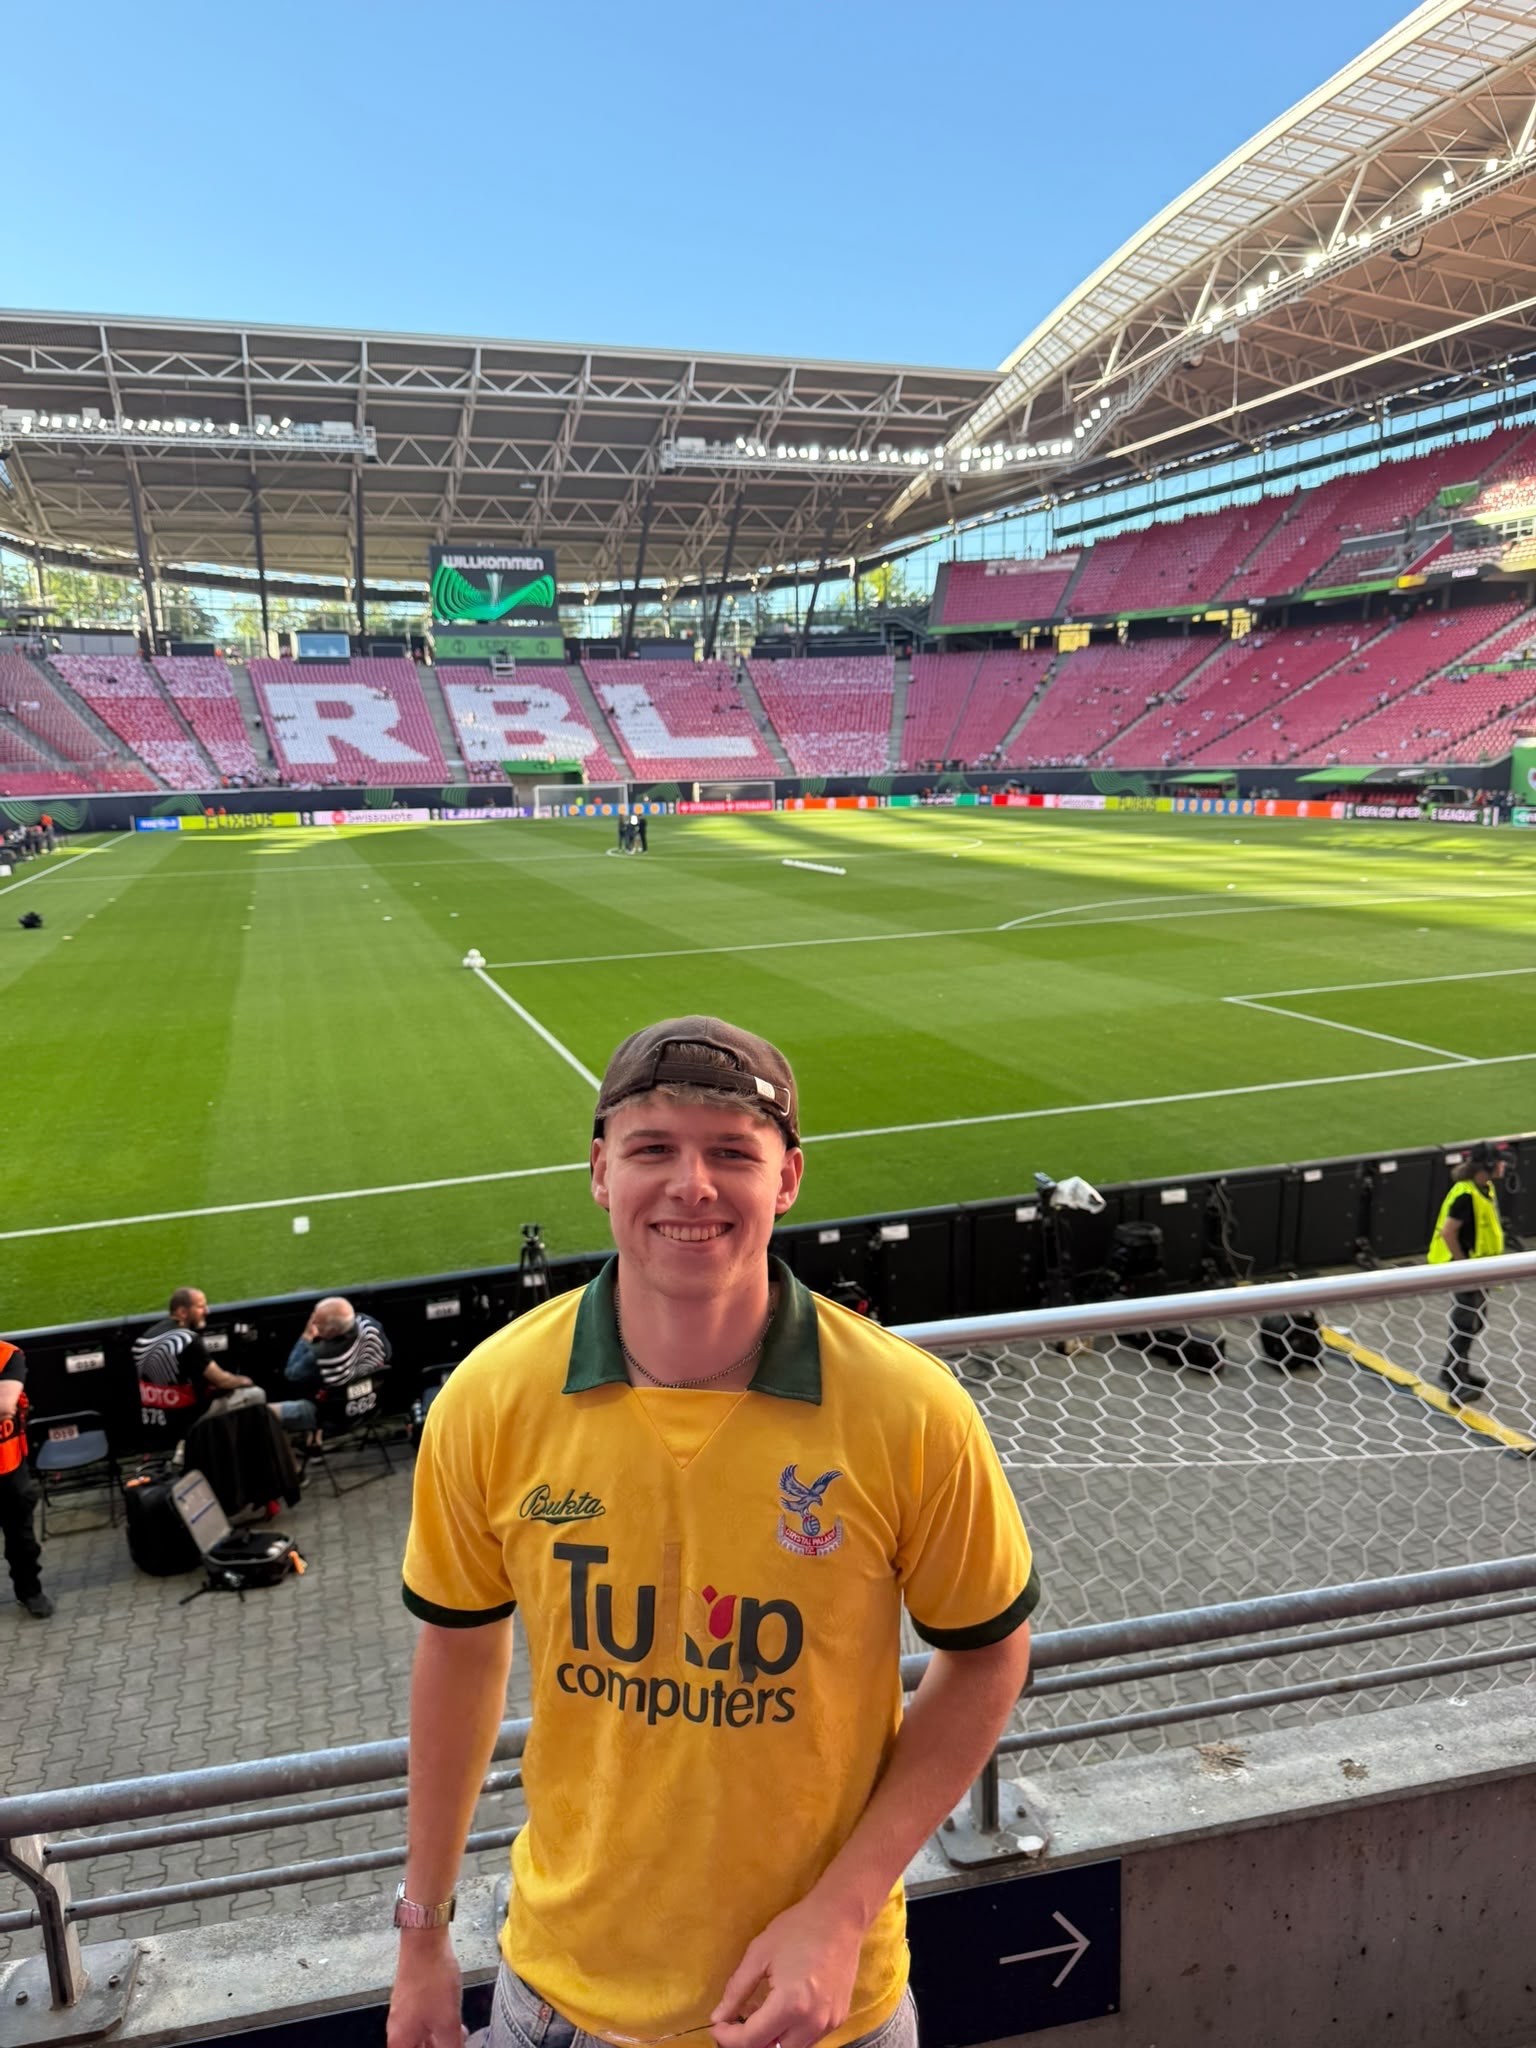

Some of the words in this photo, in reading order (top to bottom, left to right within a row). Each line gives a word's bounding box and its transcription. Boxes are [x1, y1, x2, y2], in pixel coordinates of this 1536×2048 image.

[441, 554, 545, 571] WILLKOMMEN
[1355, 806, 1378, 817] UEFA
[1438, 808, 1479, 822] LEAGUE
[520, 1484, 606, 1522] Bukta
[556, 1662, 797, 1729] computers
